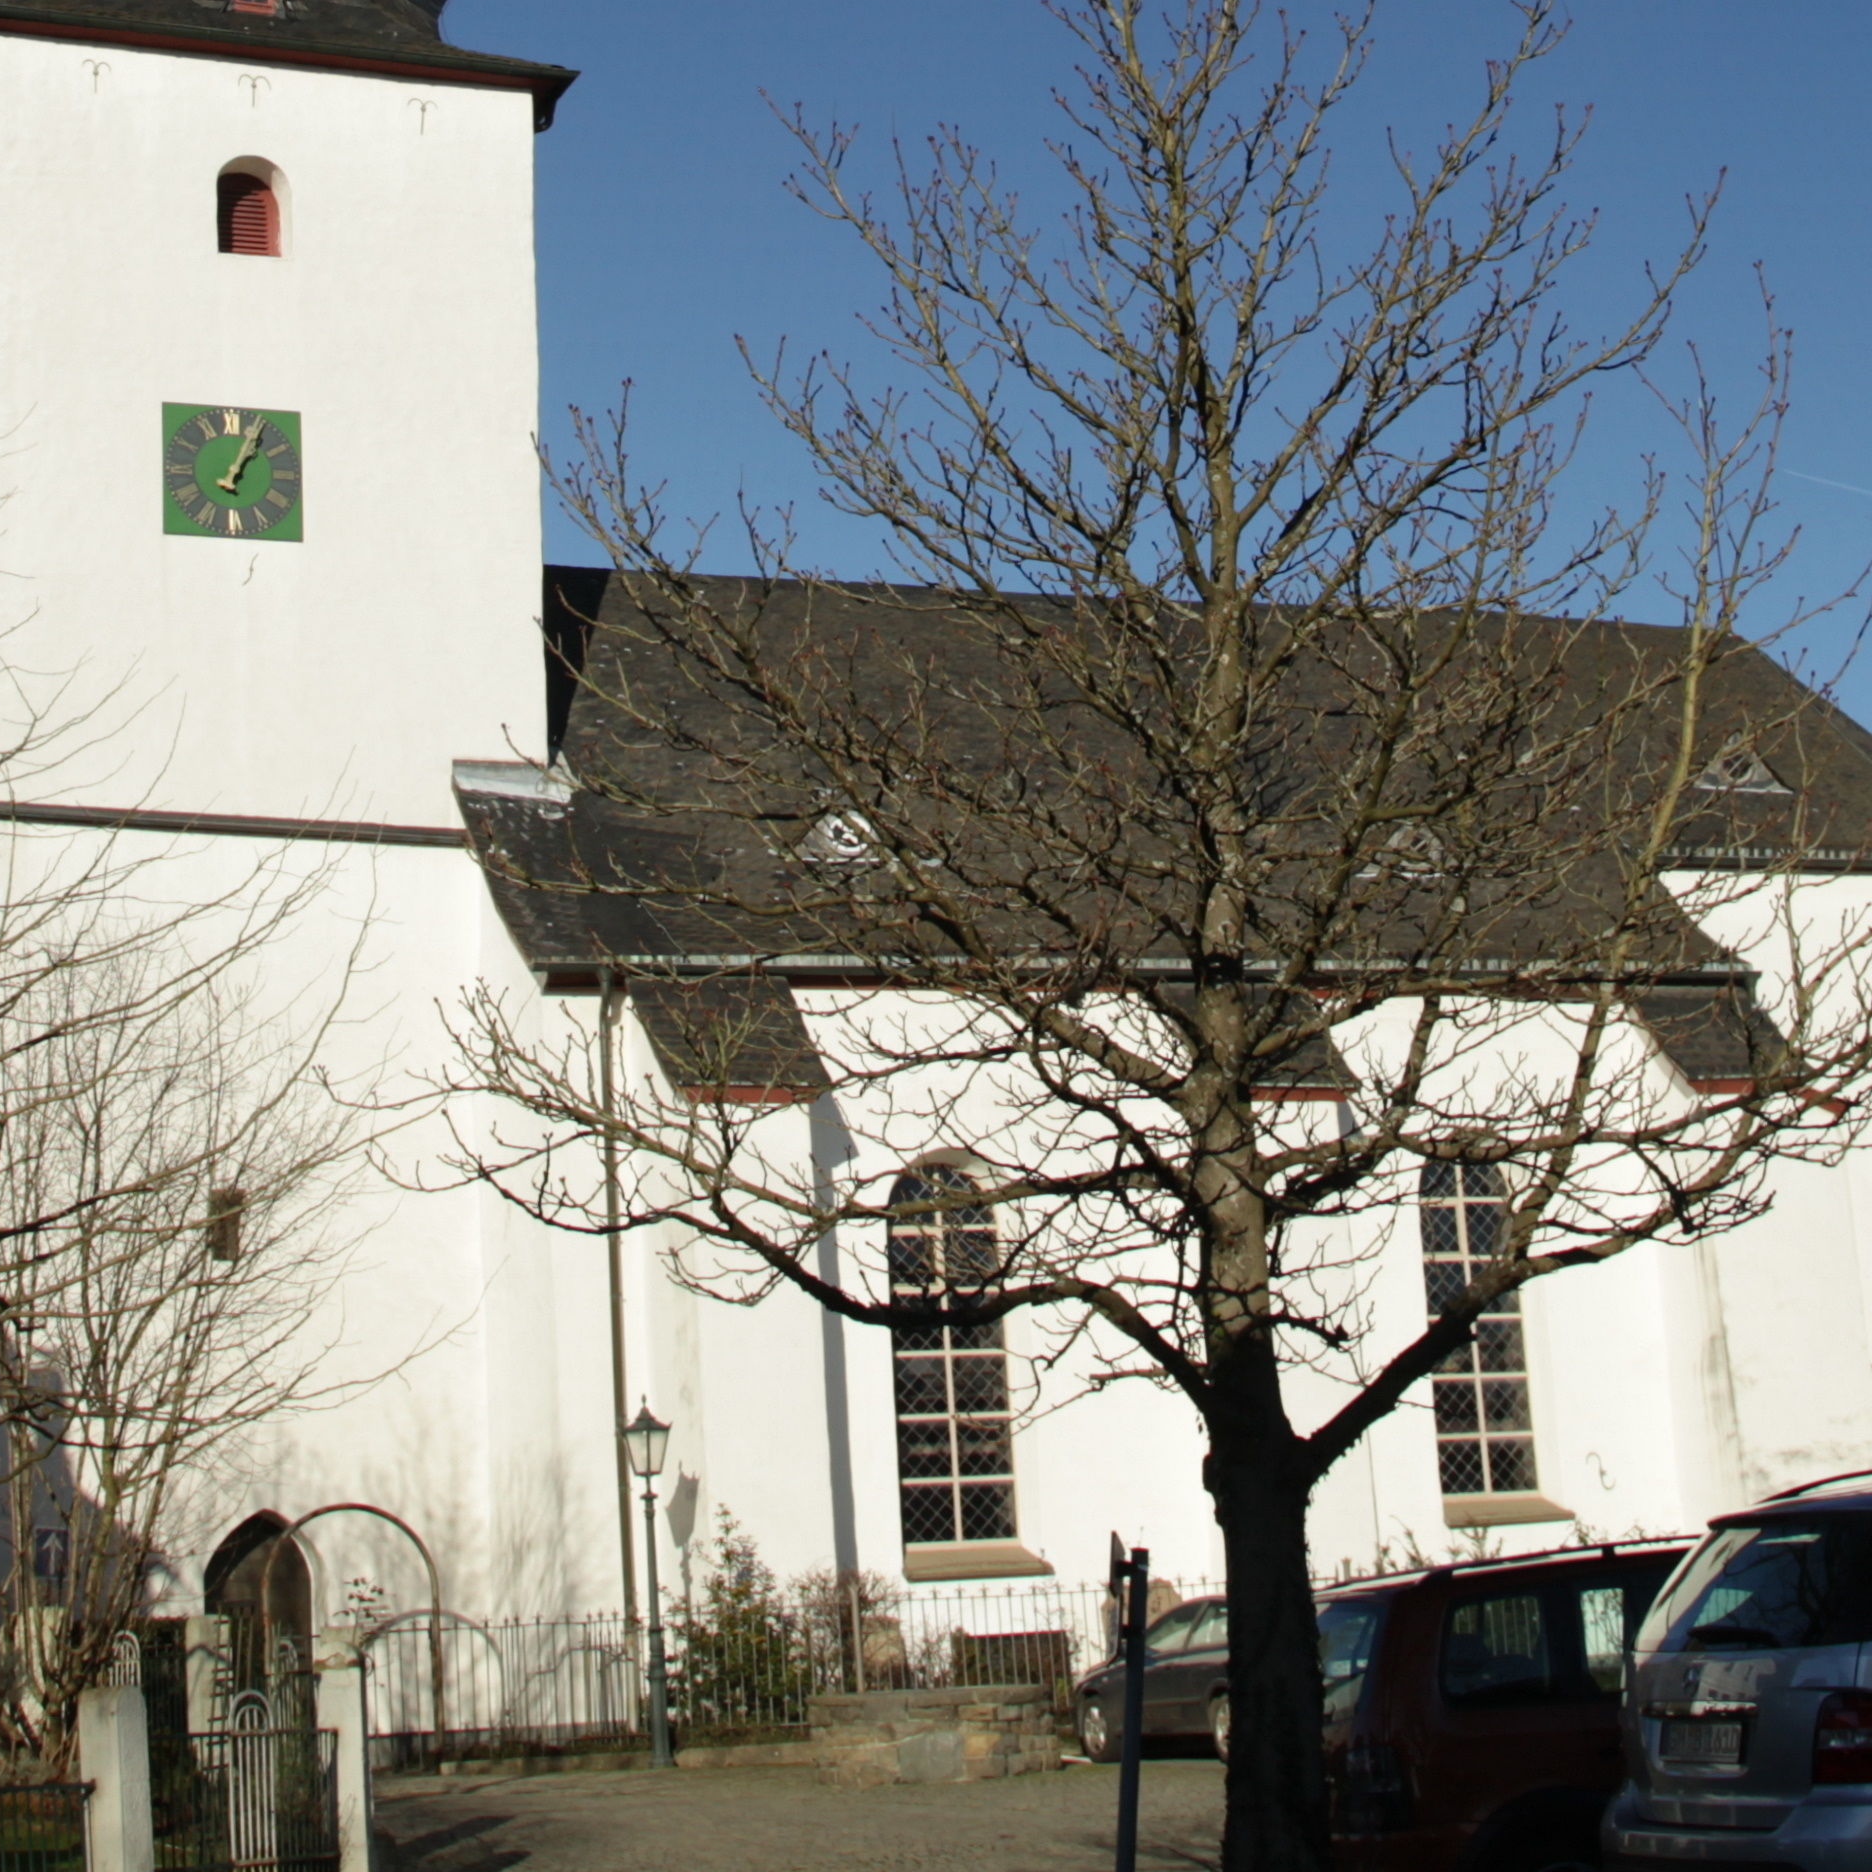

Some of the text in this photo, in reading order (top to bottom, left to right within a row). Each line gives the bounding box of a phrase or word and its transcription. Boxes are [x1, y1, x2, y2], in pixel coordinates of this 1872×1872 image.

[195, 415, 217, 440] XI
[223, 412, 240, 435] XII
[229, 509, 243, 532] VI
[253, 505, 268, 526] V
